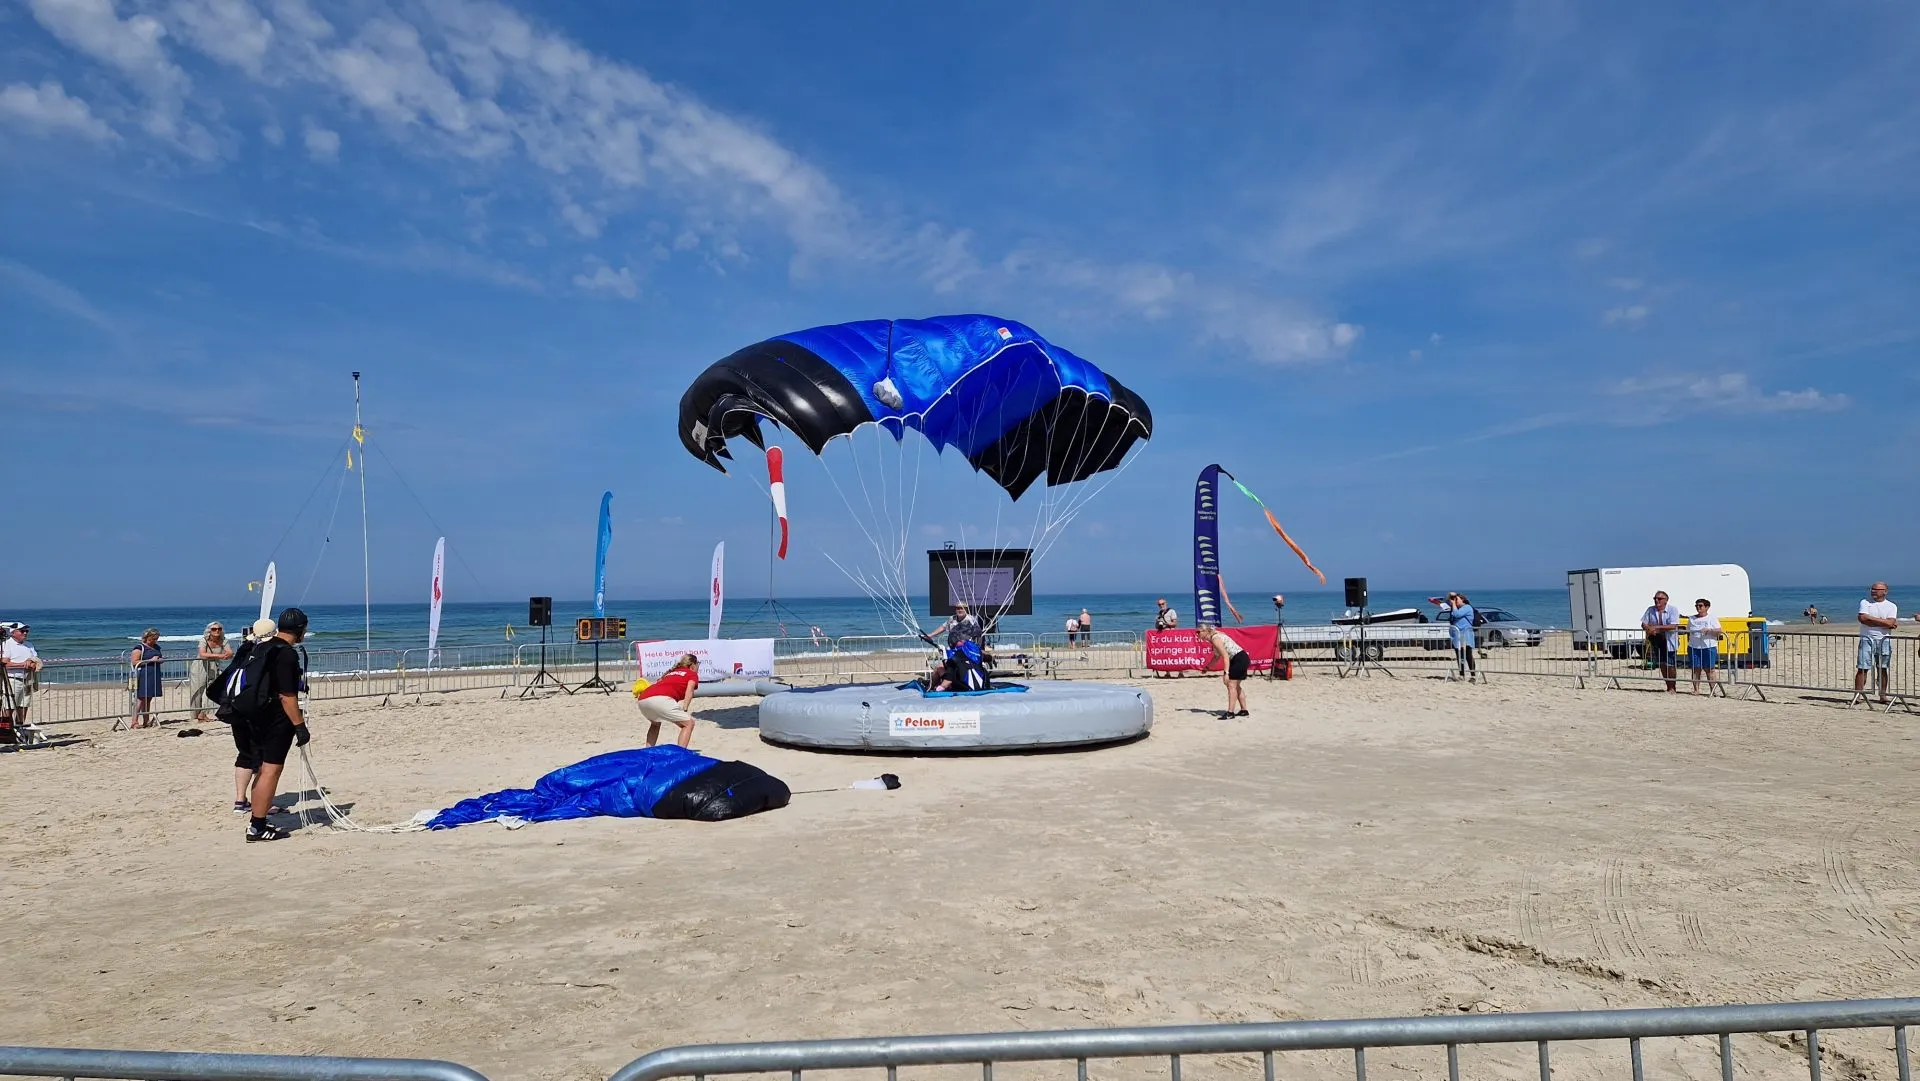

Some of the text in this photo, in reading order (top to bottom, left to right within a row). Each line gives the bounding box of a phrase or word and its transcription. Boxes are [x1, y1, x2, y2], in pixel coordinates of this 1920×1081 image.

[1151, 635, 1159, 643] Er
[1161, 635, 1172, 643] du
[1174, 635, 1193, 643] klar
[1150, 646, 1183, 656] springe
[1184, 646, 1196, 654] ud
[1150, 657, 1205, 666] bankskifte?
[905, 717, 945, 729] Pelany
